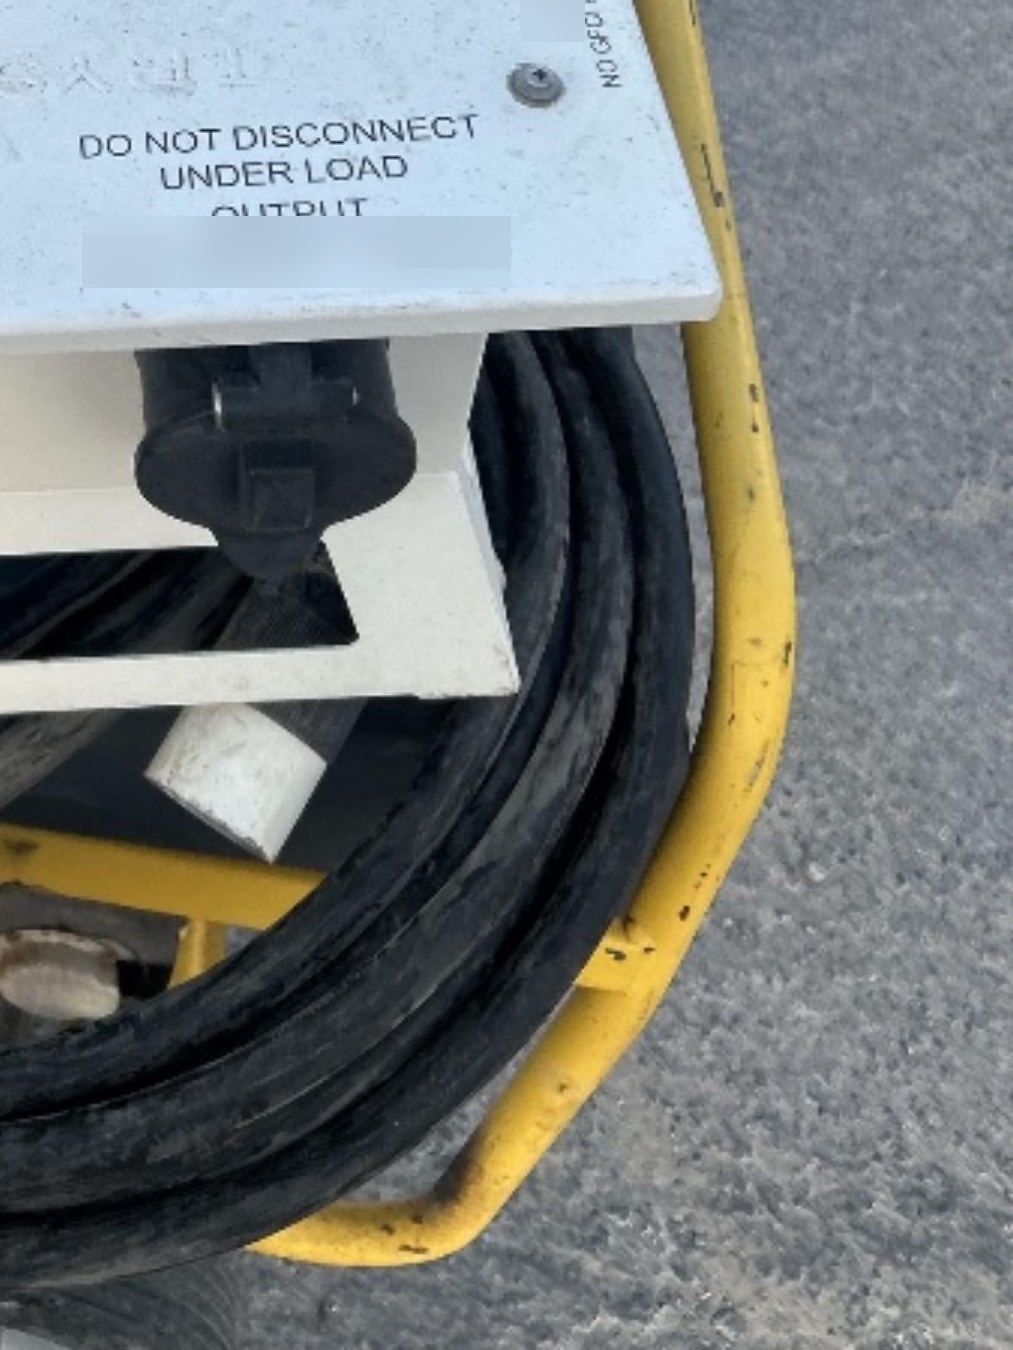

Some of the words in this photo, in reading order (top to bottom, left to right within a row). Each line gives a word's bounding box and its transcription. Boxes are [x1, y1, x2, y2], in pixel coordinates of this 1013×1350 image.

[595, 59, 622, 89] NO
[78, 133, 132, 159] DO
[144, 127, 222, 154] NOT
[232, 113, 480, 151] DISCONNECT
[160, 161, 294, 190] UNDER
[304, 154, 408, 184] LOAD
